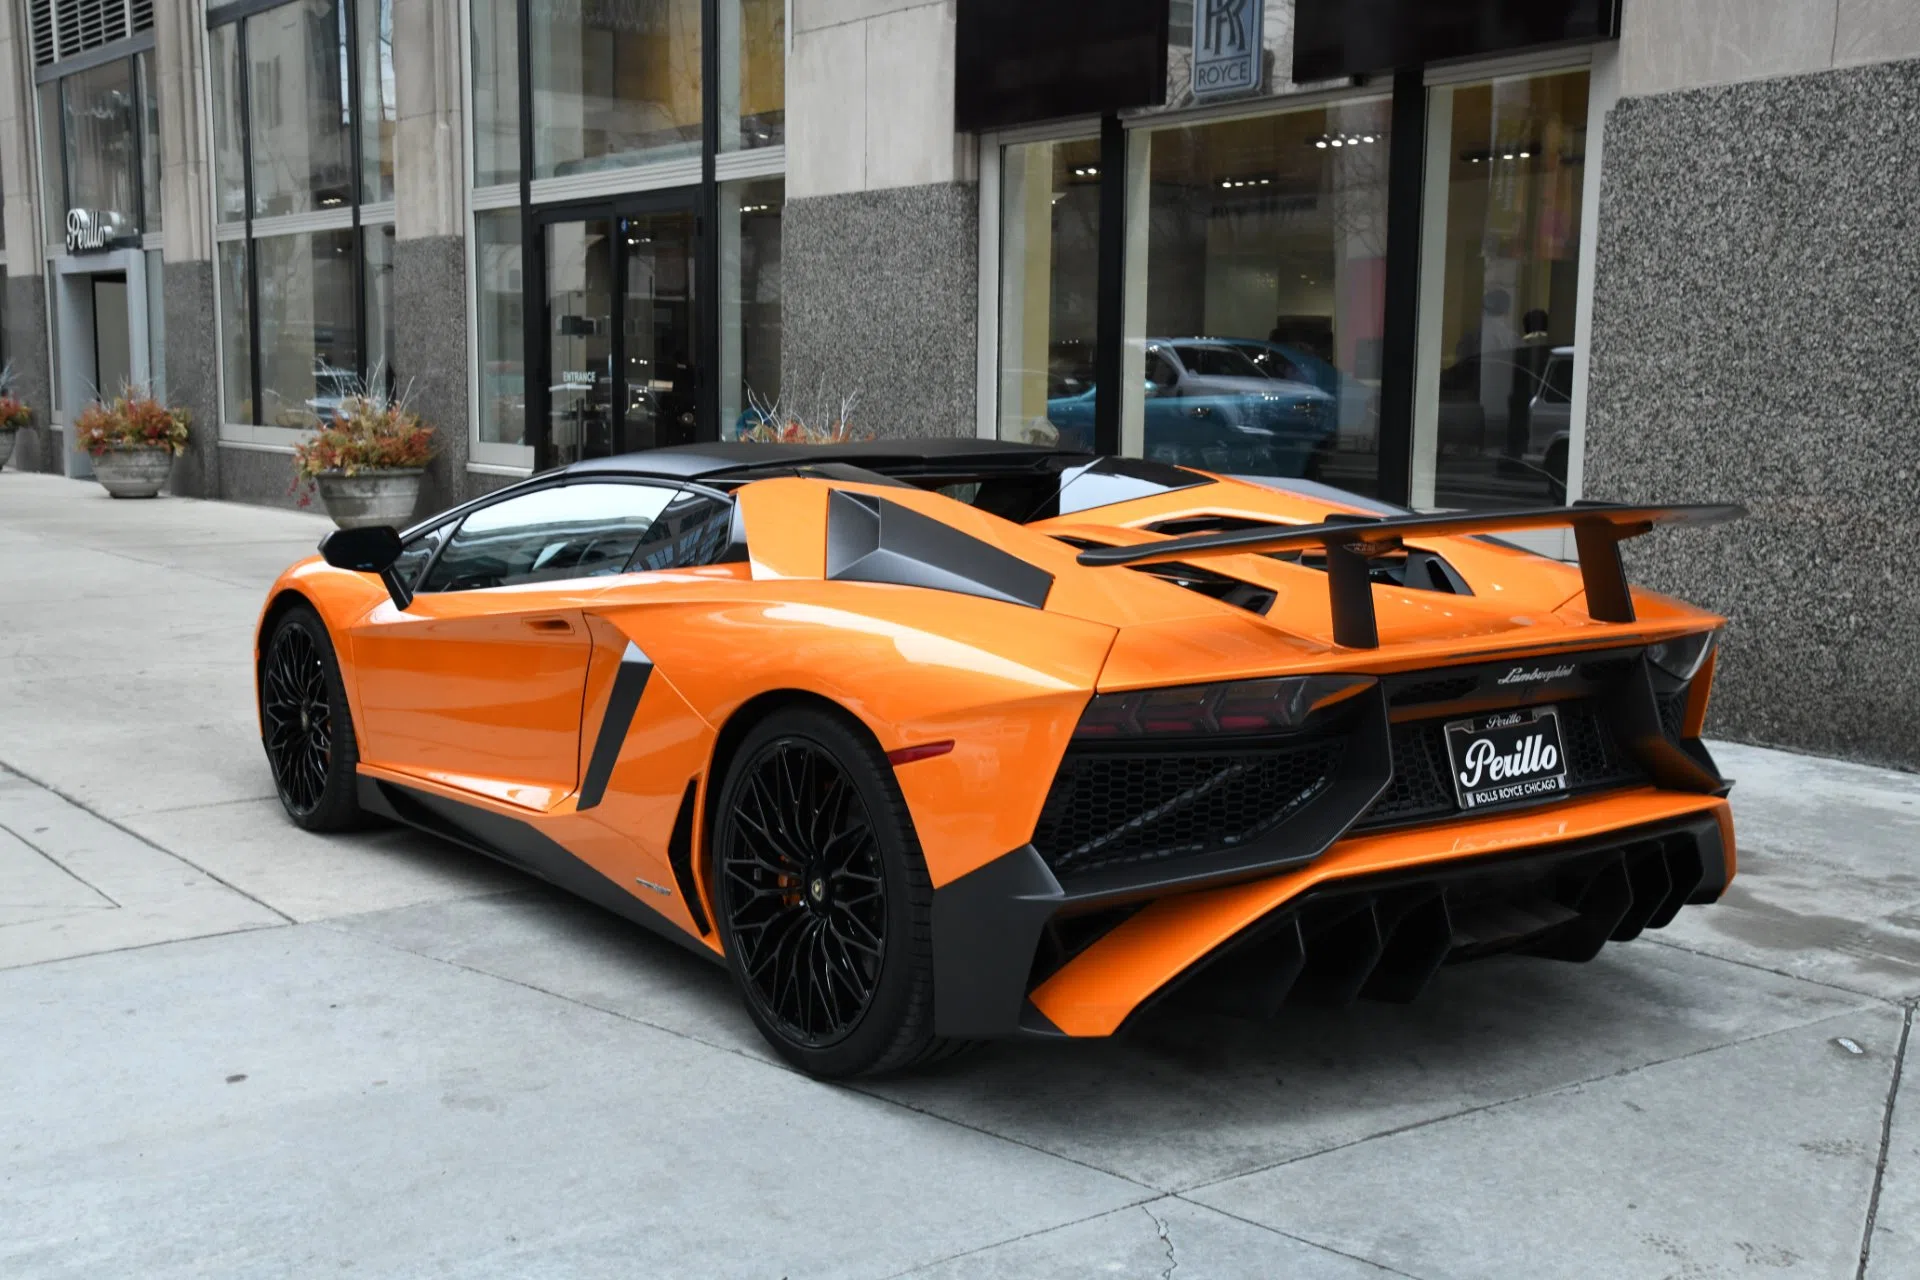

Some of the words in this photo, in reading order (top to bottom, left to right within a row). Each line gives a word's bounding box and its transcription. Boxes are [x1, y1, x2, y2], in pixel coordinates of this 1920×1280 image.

[1198, 61, 1248, 86] ROYCE
[562, 371, 596, 383] ENTRANCE
[1497, 663, 1575, 685] Lamborghini
[1486, 713, 1522, 729] Perillo
[1460, 734, 1558, 788] Perillo
[1475, 790, 1498, 804] ROLLS
[1498, 784, 1524, 799] ROYCE
[1524, 778, 1556, 795] CHICAGO
